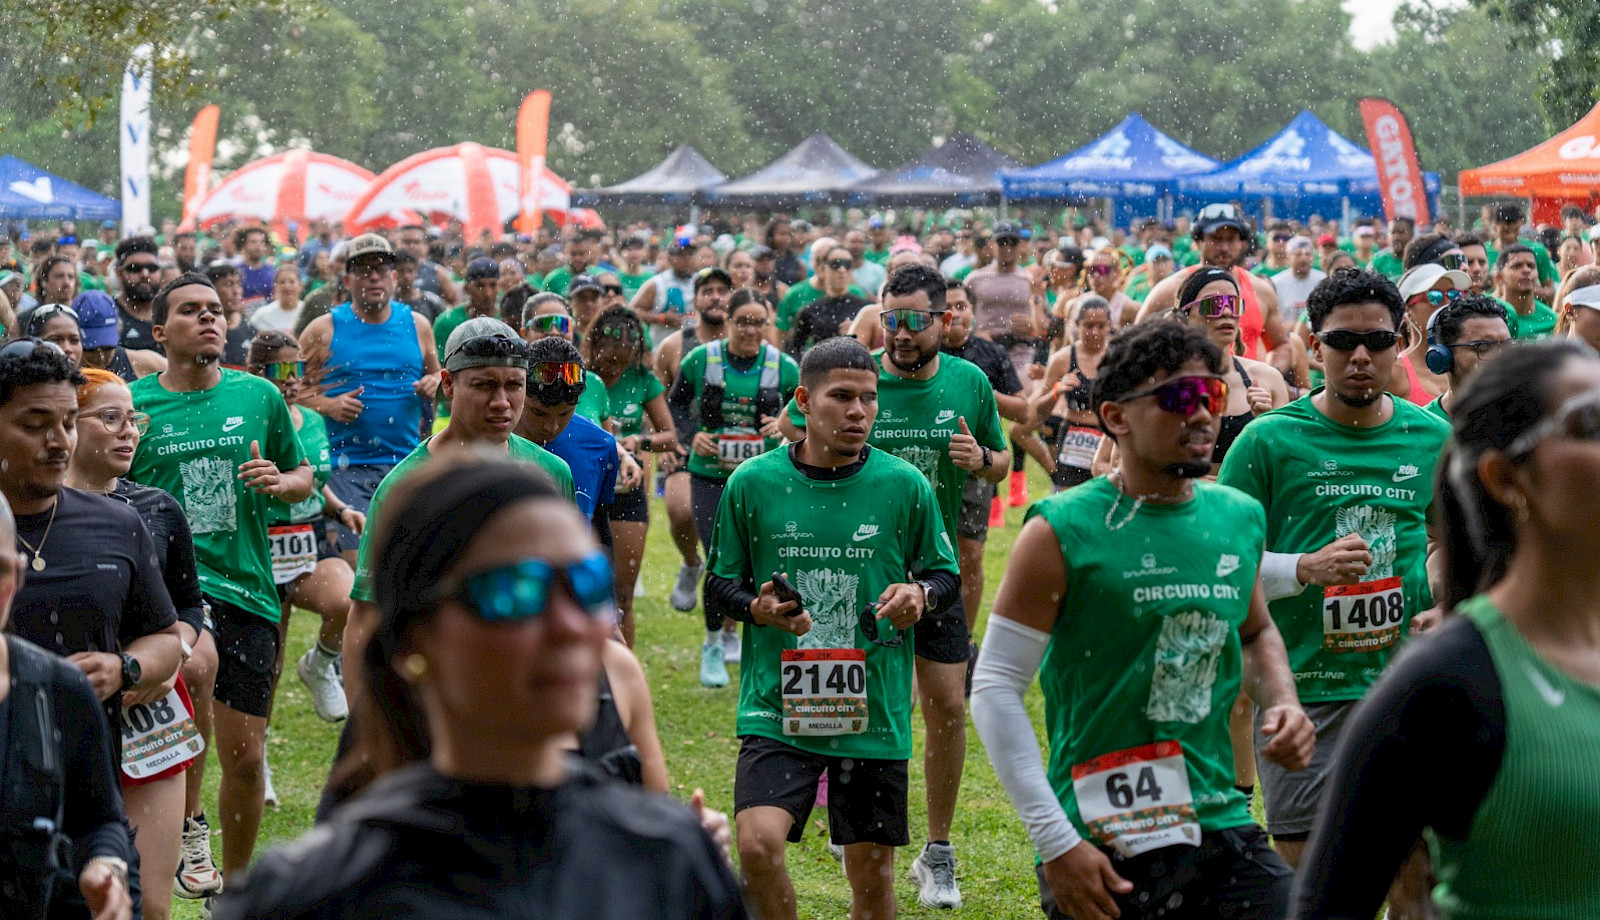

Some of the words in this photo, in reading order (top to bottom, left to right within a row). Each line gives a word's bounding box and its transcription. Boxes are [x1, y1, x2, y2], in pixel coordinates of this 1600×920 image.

[226, 416, 244, 425] RUN
[874, 429, 928, 439] CIRCUITO
[930, 429, 955, 438] CITY
[157, 439, 216, 456] CIRCUITO
[218, 435, 244, 446] CITY
[721, 442, 761, 458] 1181
[1398, 464, 1419, 475] RUN
[1315, 484, 1383, 496] CIRCUITO
[1385, 487, 1416, 501] CITY
[858, 524, 879, 534] RUN
[778, 546, 842, 558] CIRCUITO
[845, 548, 875, 559] CITY
[1133, 584, 1211, 602] CIRCUITO
[1212, 584, 1240, 600] CITY
[1326, 592, 1404, 630] 1408
[1338, 638, 1379, 648] CIRCUITO
[817, 652, 833, 660] 21K
[783, 664, 865, 695] 2140
[795, 705, 836, 713] CIRCUITO
[837, 705, 856, 713] CITY
[808, 722, 843, 730] MEDALLA
[126, 738, 164, 759] CIRCUITO
[165, 730, 184, 743] CITY
[145, 750, 182, 769] MEDALLA
[1105, 766, 1163, 809] 64
[1103, 817, 1156, 834] CIRCUITO
[1156, 814, 1180, 826] CITY
[1125, 834, 1172, 848] MEDALLA
